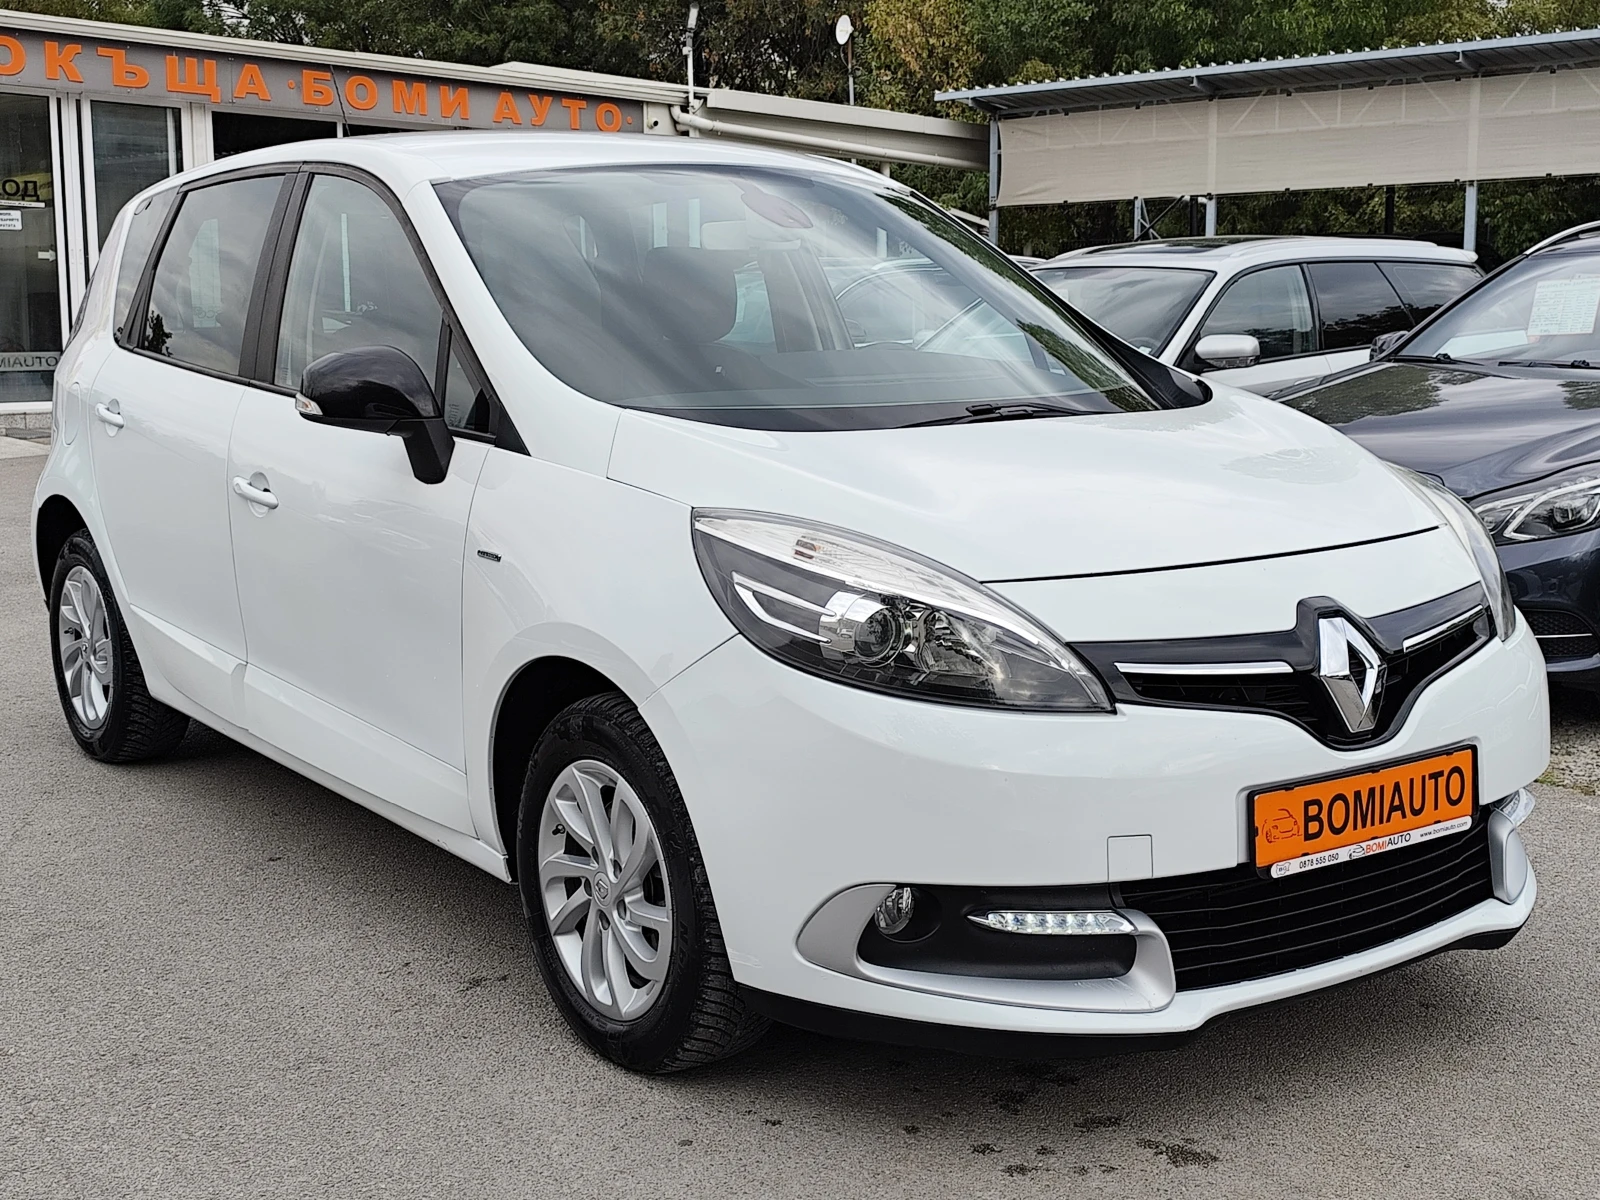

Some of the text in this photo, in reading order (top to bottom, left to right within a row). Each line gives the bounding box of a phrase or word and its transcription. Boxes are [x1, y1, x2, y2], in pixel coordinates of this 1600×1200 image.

[302, 69, 470, 120] БОМИ
[493, 91, 623, 132] АУТО
[0, 179, 40, 201] ОД
[1303, 765, 1466, 842] BOMIAUTO
[1420, 821, 1468, 838] www.bomiauto.com
[1365, 832, 1411, 854] BOMIAUTO
[1299, 852, 1339, 869] 0878 555 050
